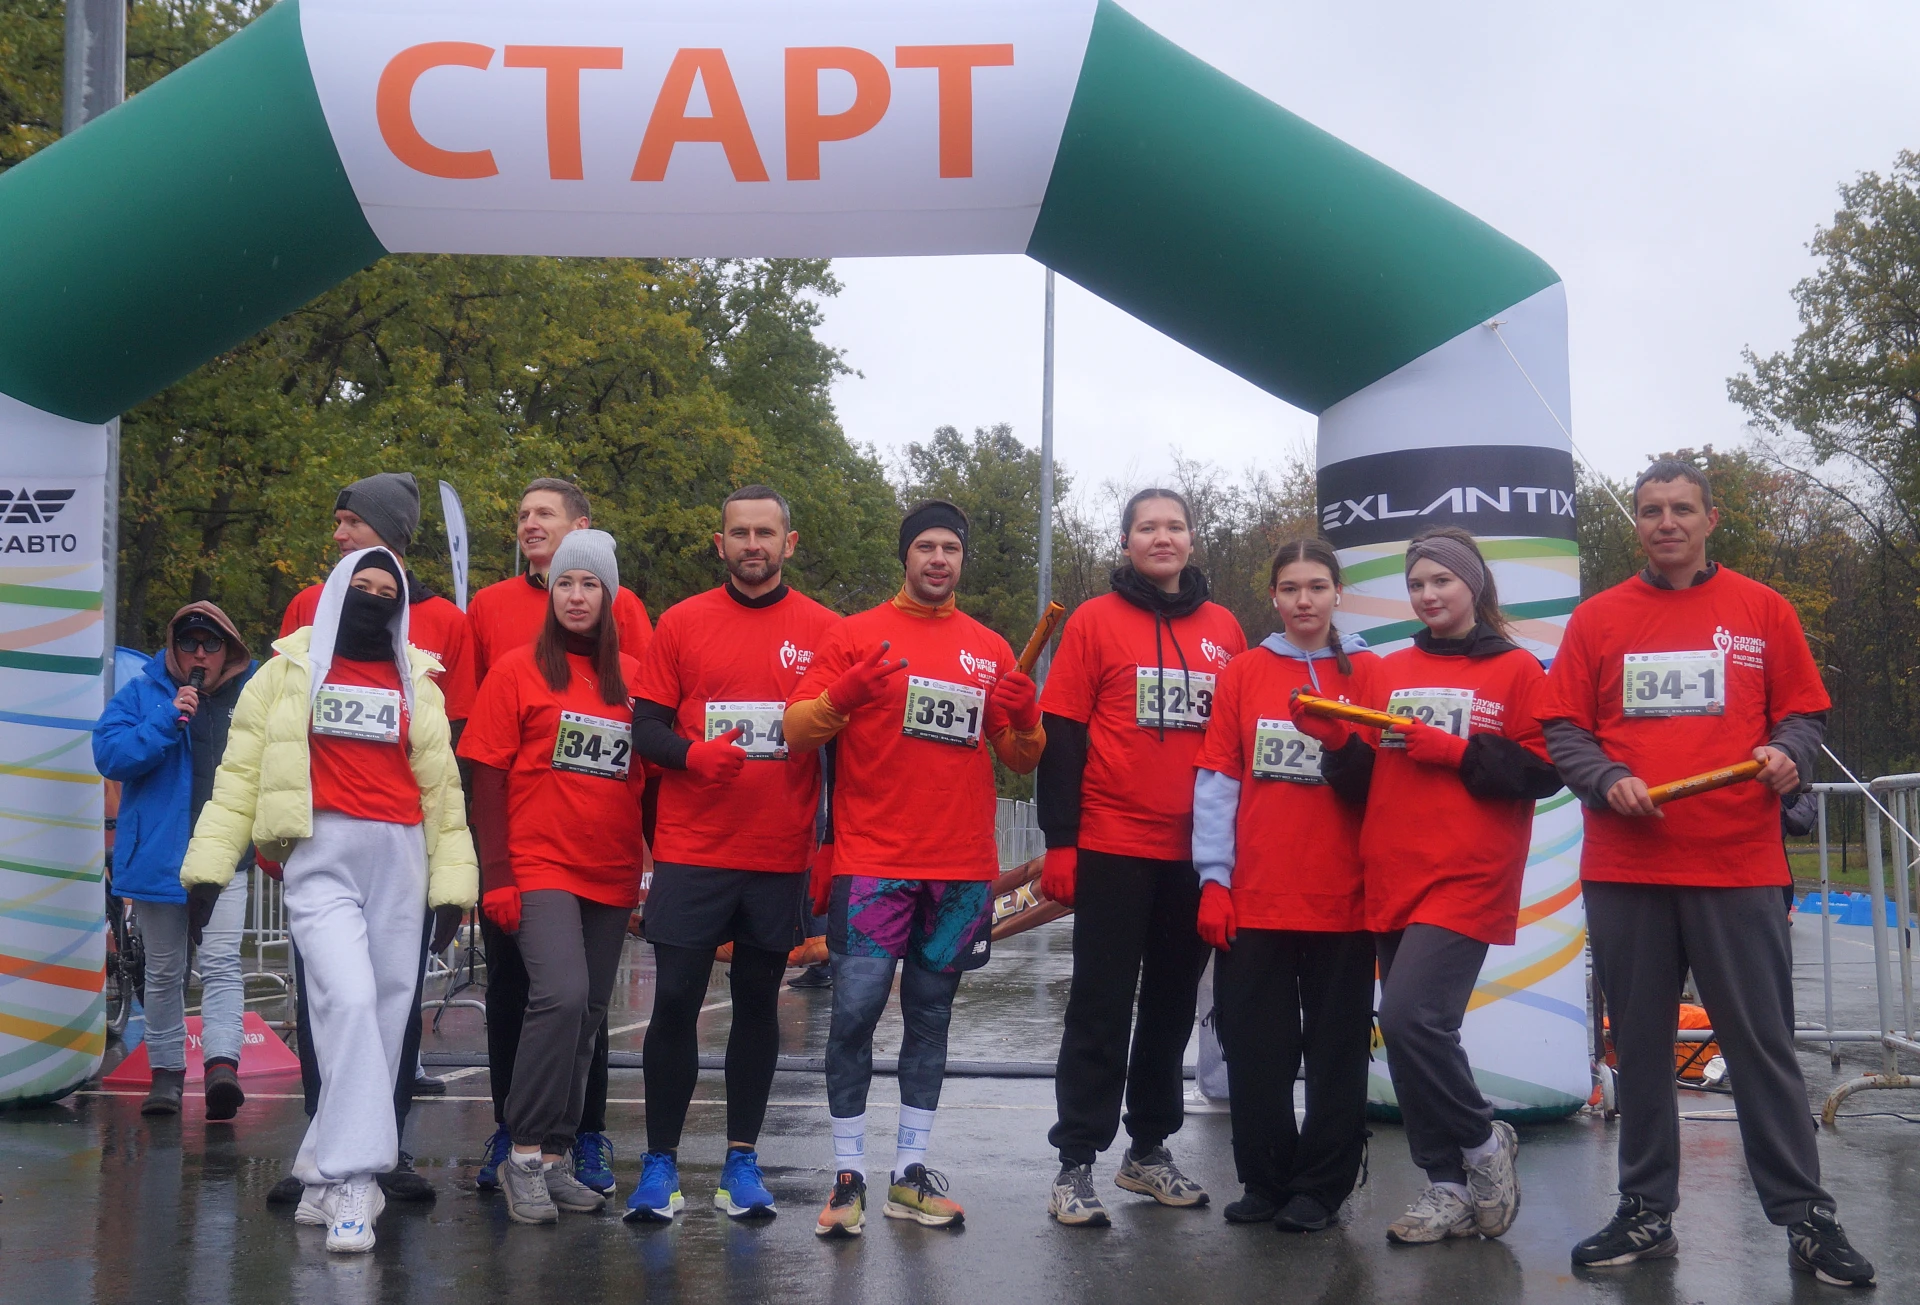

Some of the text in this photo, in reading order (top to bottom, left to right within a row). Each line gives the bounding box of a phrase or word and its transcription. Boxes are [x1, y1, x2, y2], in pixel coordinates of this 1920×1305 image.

[376, 41, 1015, 182] СТАРТ
[1322, 486, 1576, 531] EXLANTIX
[0, 533, 77, 554] АВТО
[1146, 684, 1213, 718] 32-3
[1635, 668, 1716, 701] 34-1
[322, 697, 398, 730] 32-4
[915, 695, 979, 734] 33-1
[563, 729, 630, 768] 34-2
